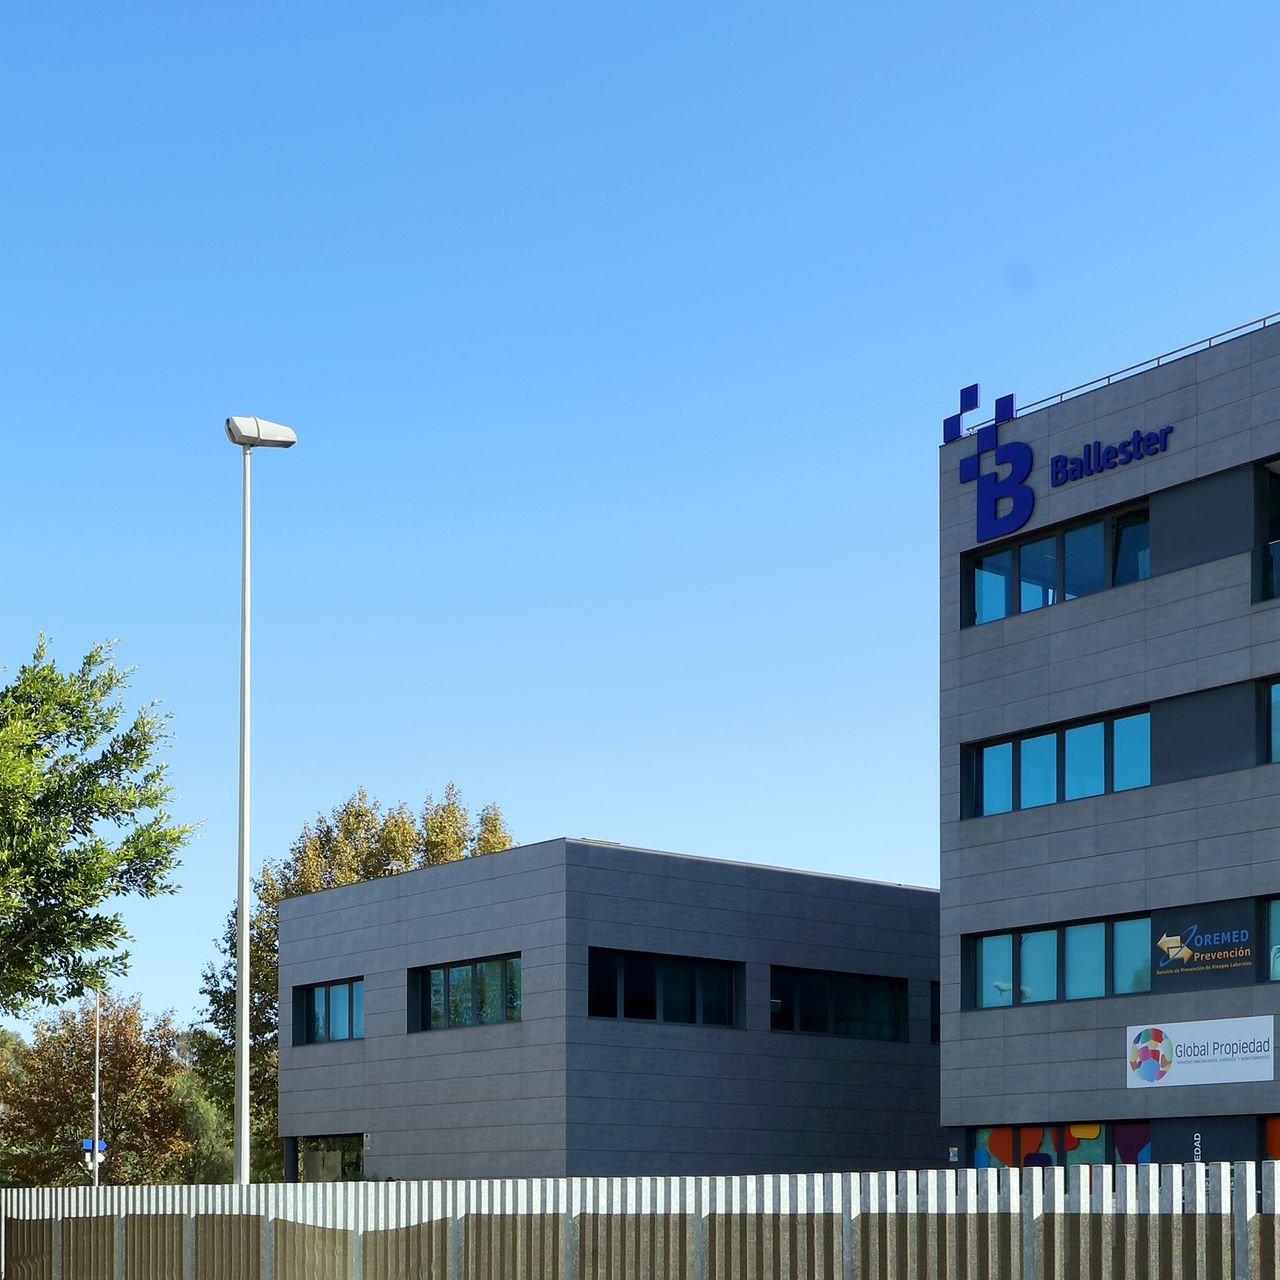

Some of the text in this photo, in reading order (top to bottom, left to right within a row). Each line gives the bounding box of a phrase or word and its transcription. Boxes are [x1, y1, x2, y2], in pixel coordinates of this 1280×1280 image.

[1050, 425, 1174, 488] Ballester
[1194, 930, 1249, 947] OREMED
[1193, 946, 1251, 962] Prevención
[1175, 1037, 1270, 1058] Global Propiedad
